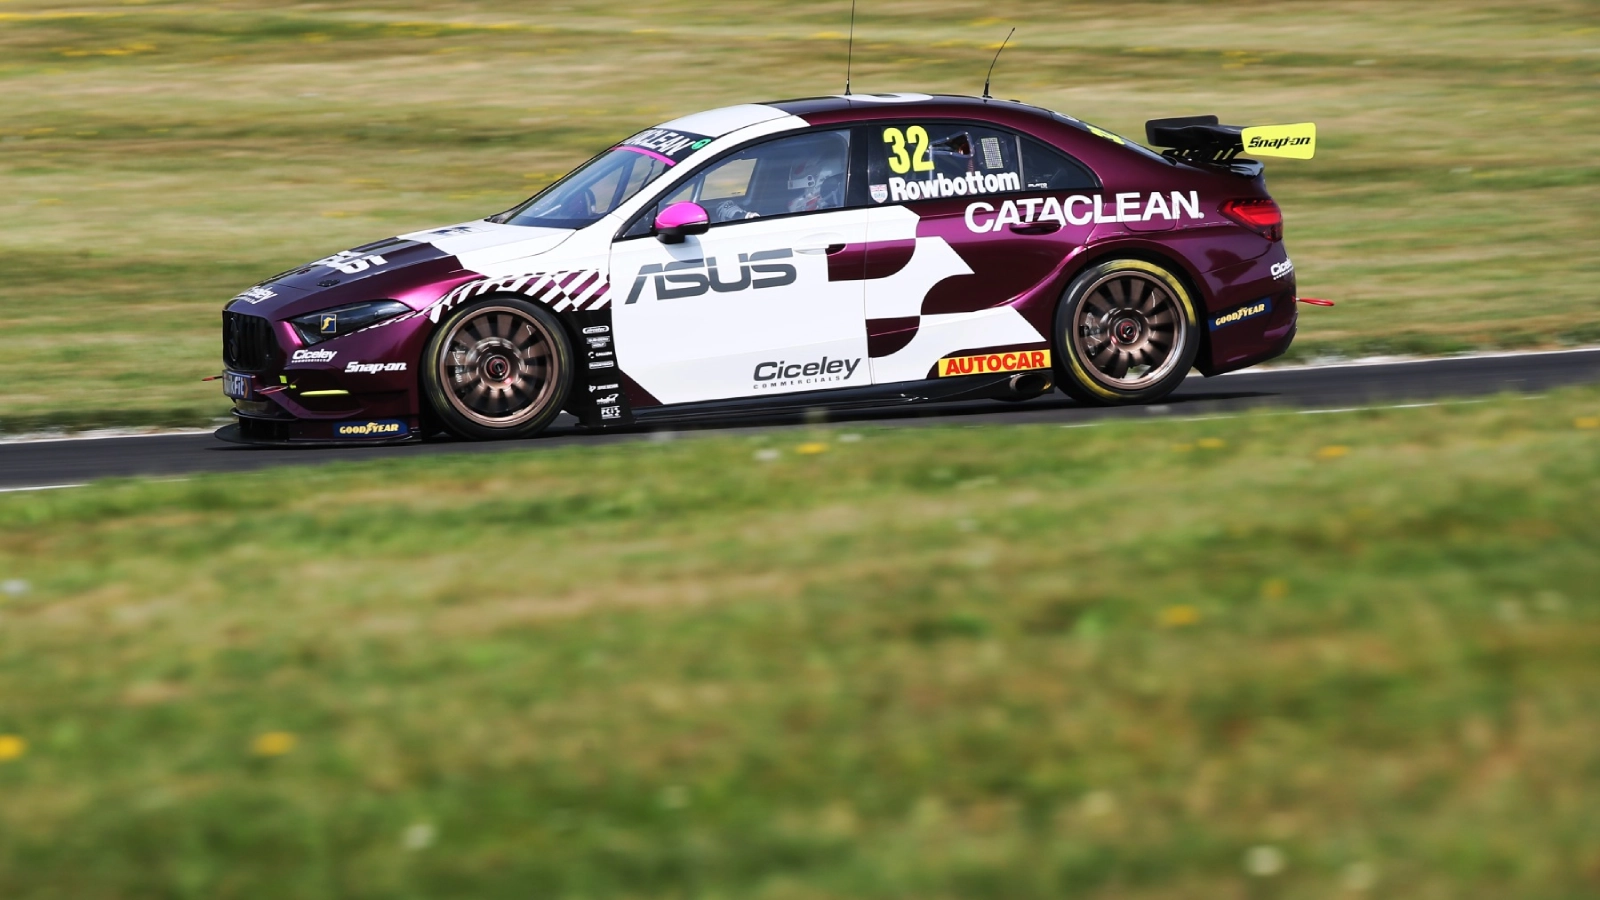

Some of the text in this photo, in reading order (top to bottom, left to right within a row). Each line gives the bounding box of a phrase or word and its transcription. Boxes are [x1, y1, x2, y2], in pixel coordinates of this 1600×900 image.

[883, 125, 935, 174] 32
[1248, 136, 1311, 149] Snap-on
[889, 171, 1020, 201] Rowbottom
[624, 248, 797, 305] ASUS
[1215, 303, 1266, 326] GOODYEAR
[292, 348, 338, 362] Ciceley
[945, 351, 1045, 376] AUTOCAR
[344, 361, 407, 374] Snap-on
[753, 356, 861, 381] Ciceley
[753, 376, 840, 389] COMMERCIALS
[339, 422, 399, 434] GOODYEAR
